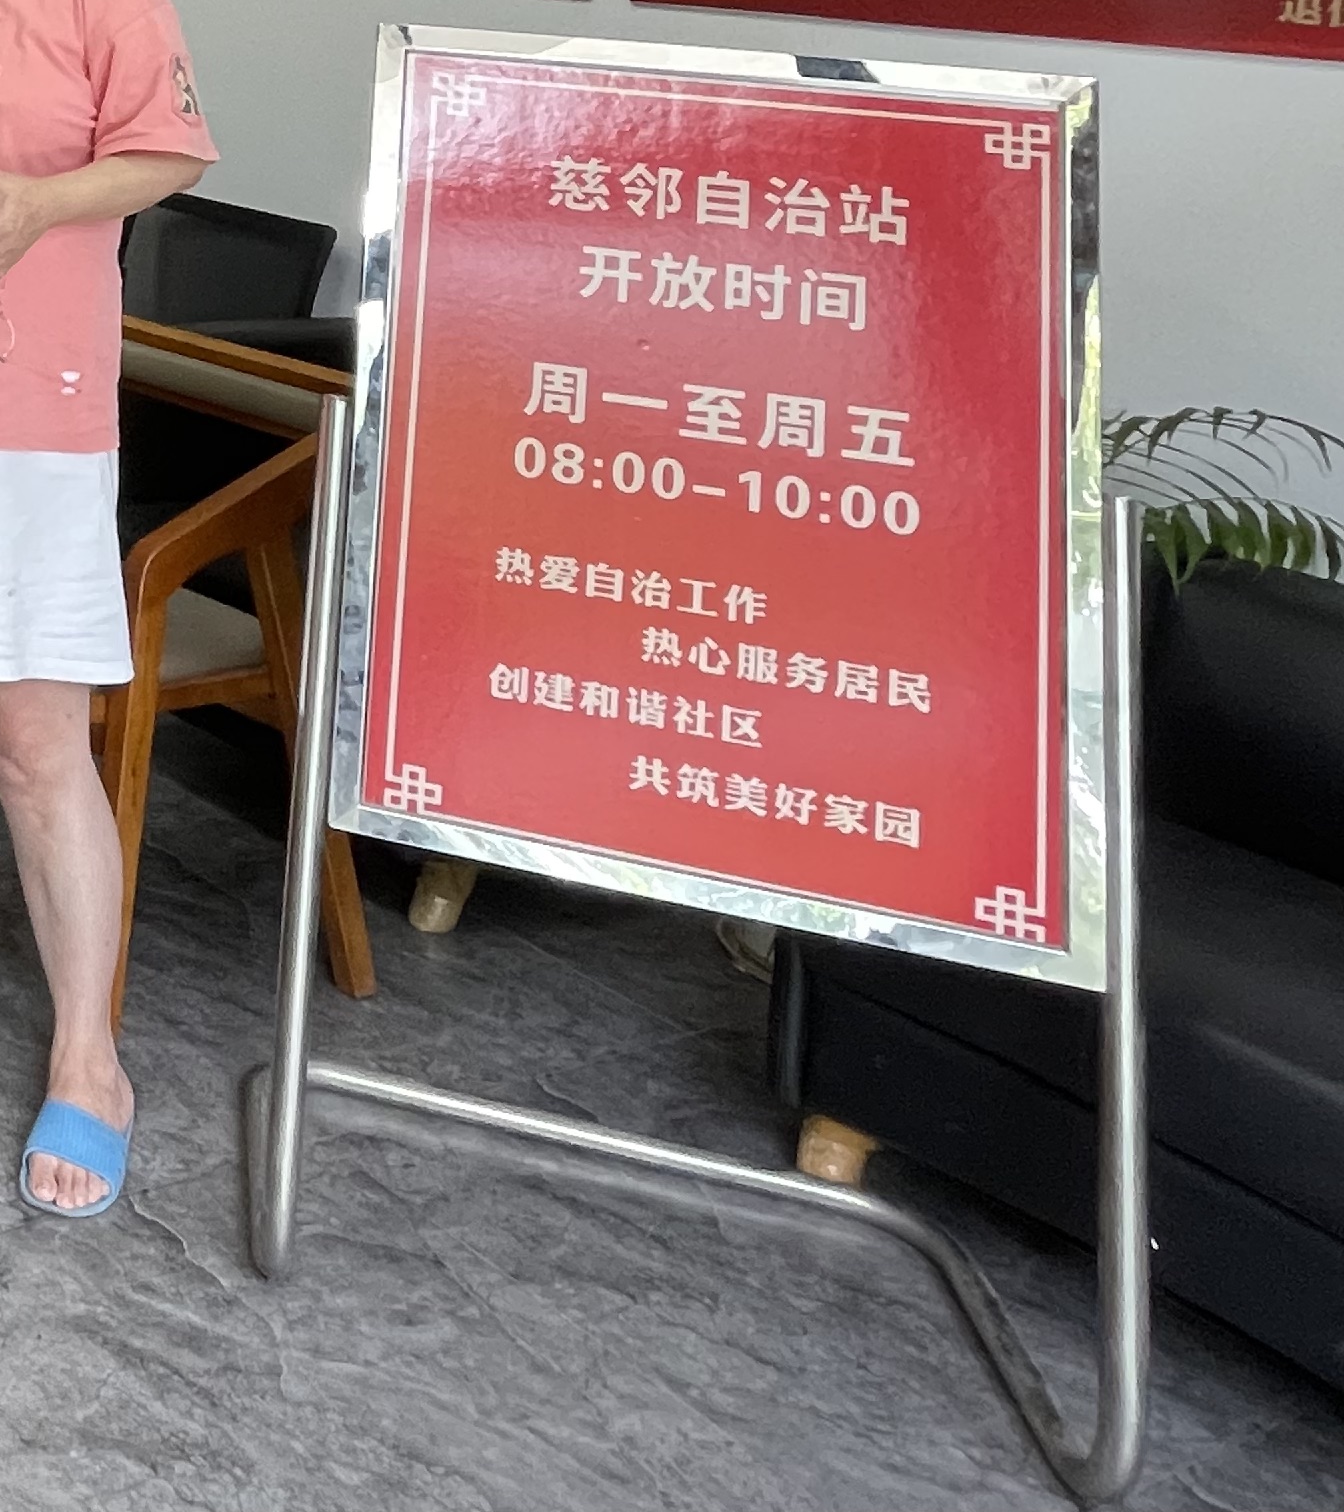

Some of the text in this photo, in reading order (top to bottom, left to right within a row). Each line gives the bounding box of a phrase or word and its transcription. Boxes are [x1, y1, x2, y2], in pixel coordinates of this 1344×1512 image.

[548, 155, 910, 246] 慈邻自治站
[578, 244, 868, 332] 开放时间
[523, 360, 916, 467] 周一至周五
[493, 545, 769, 625] 热爱自治工作
[488, 661, 764, 749] 创建和谐社区
[640, 625, 932, 715] 热心服务居民
[627, 754, 922, 850] 共筑美好家园
